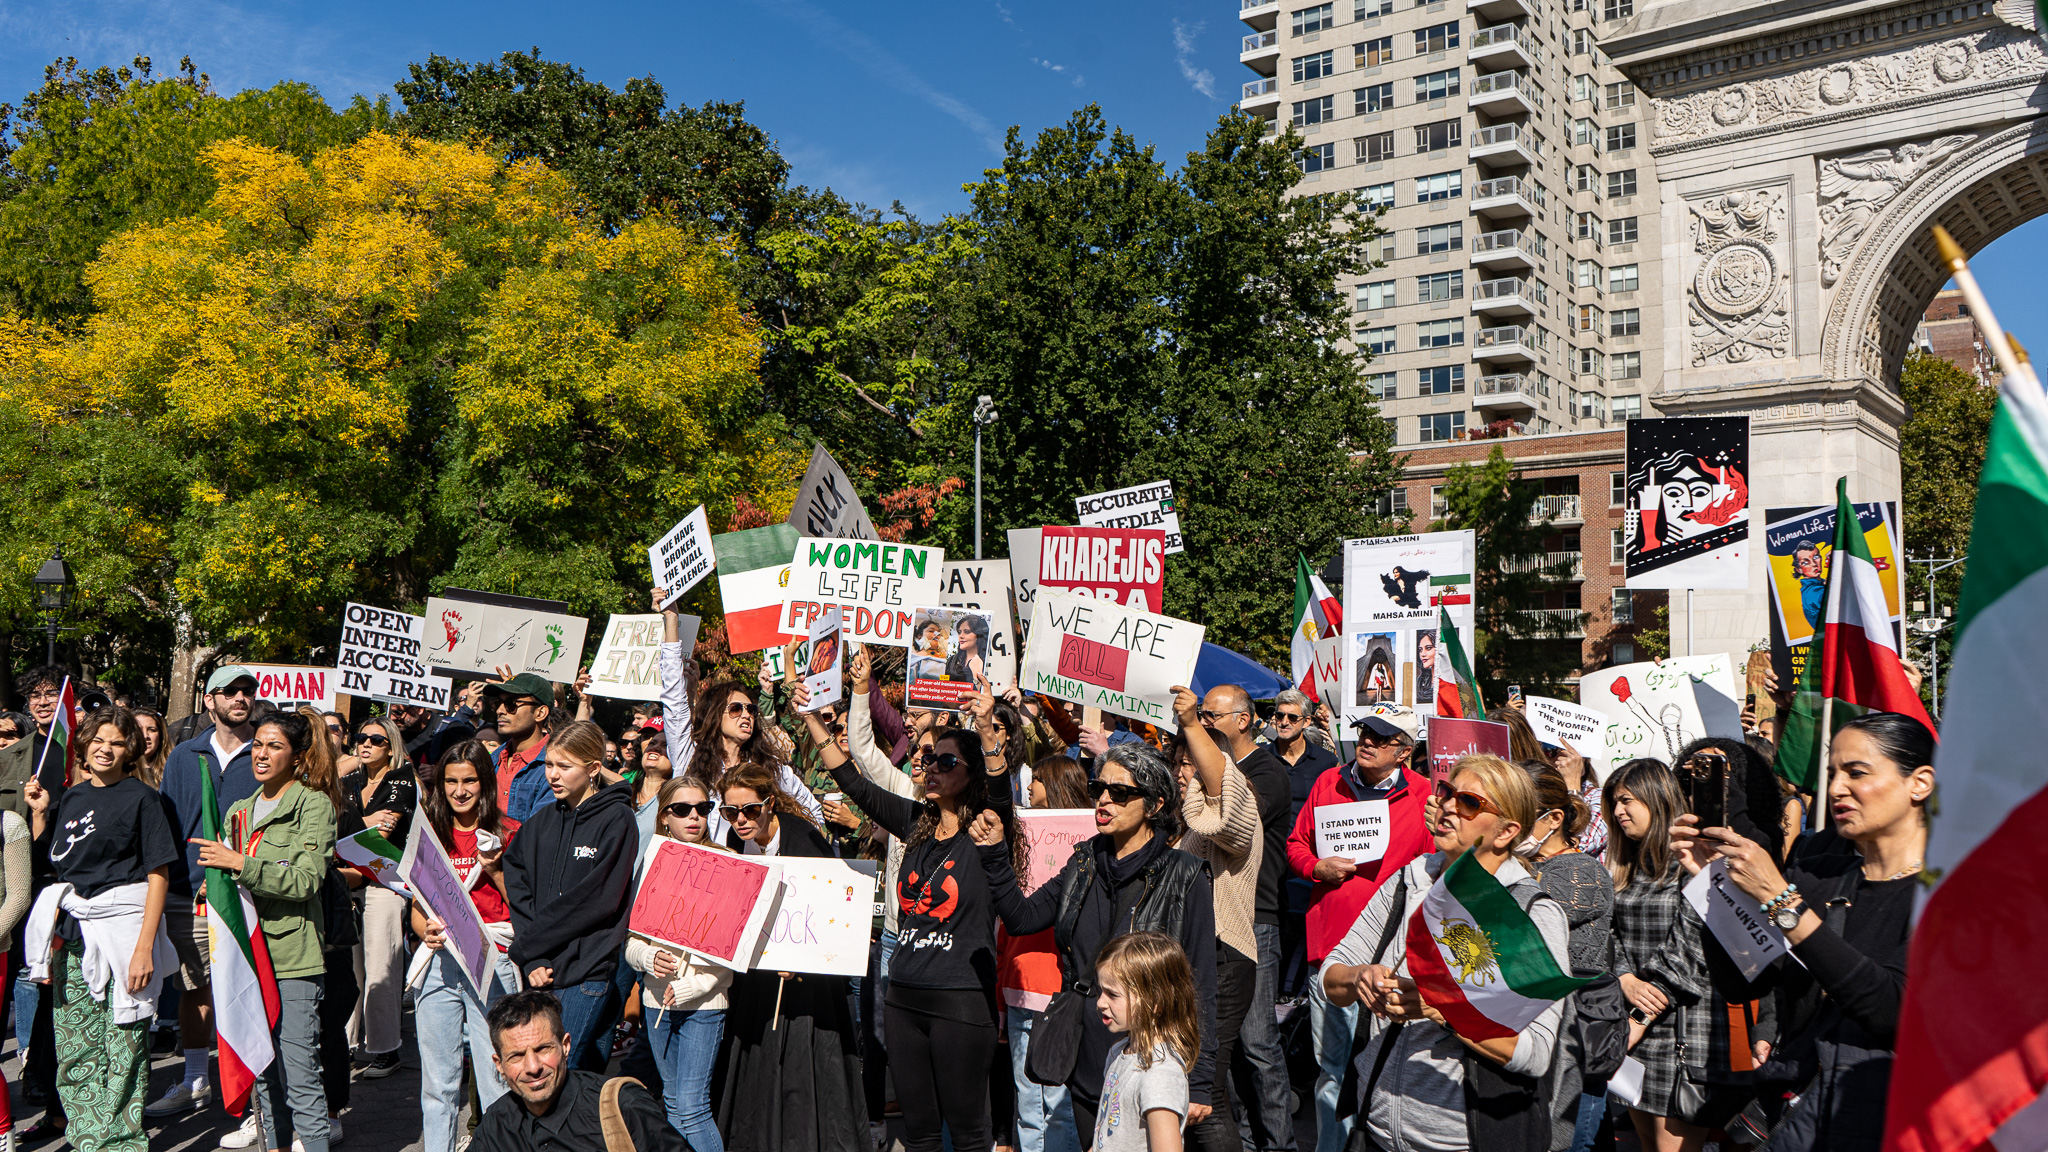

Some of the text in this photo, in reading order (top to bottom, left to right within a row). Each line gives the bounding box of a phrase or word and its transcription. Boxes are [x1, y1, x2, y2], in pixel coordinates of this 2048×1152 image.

[1079, 485, 1172, 516] ACCURATE
[1095, 510, 1164, 529] MEDIA
[660, 521, 695, 557] WE HAVE
[664, 536, 697, 569] BROKEN
[663, 547, 703, 584] THE WALL
[675, 558, 709, 591] SILENCE
[808, 543, 927, 579] WOMEN
[1042, 536, 1162, 584] KHAREJIS
[819, 572, 902, 605] LIFE
[347, 605, 413, 634] OPEN
[1049, 602, 1093, 636] WE
[1110, 617, 1173, 659] ARE
[1373, 610, 1433, 620] MAHSA AMINI
[610, 621, 665, 647] FRE
[1791, 646, 1796, 655] I
[339, 648, 426, 678] ACCESS
[598, 650, 662, 686] IRA
[1061, 639, 1114, 681] ALL
[341, 670, 449, 706] IN IRAN
[1037, 671, 1163, 719] MAHSA AMINI
[1538, 711, 1594, 733] THE WOMEN
[1541, 703, 1572, 719] STAND
[1574, 712, 1600, 725] WITH
[1544, 724, 1582, 741] OF IRAN
[1324, 829, 1379, 841] THE WOMEN
[1325, 819, 1355, 829] STAND
[1356, 816, 1382, 826] WITH
[1347, 843, 1370, 851] IRAN
[674, 852, 725, 895] FREE
[657, 895, 718, 943] IRAN
[1735, 907, 1769, 946] STAND
